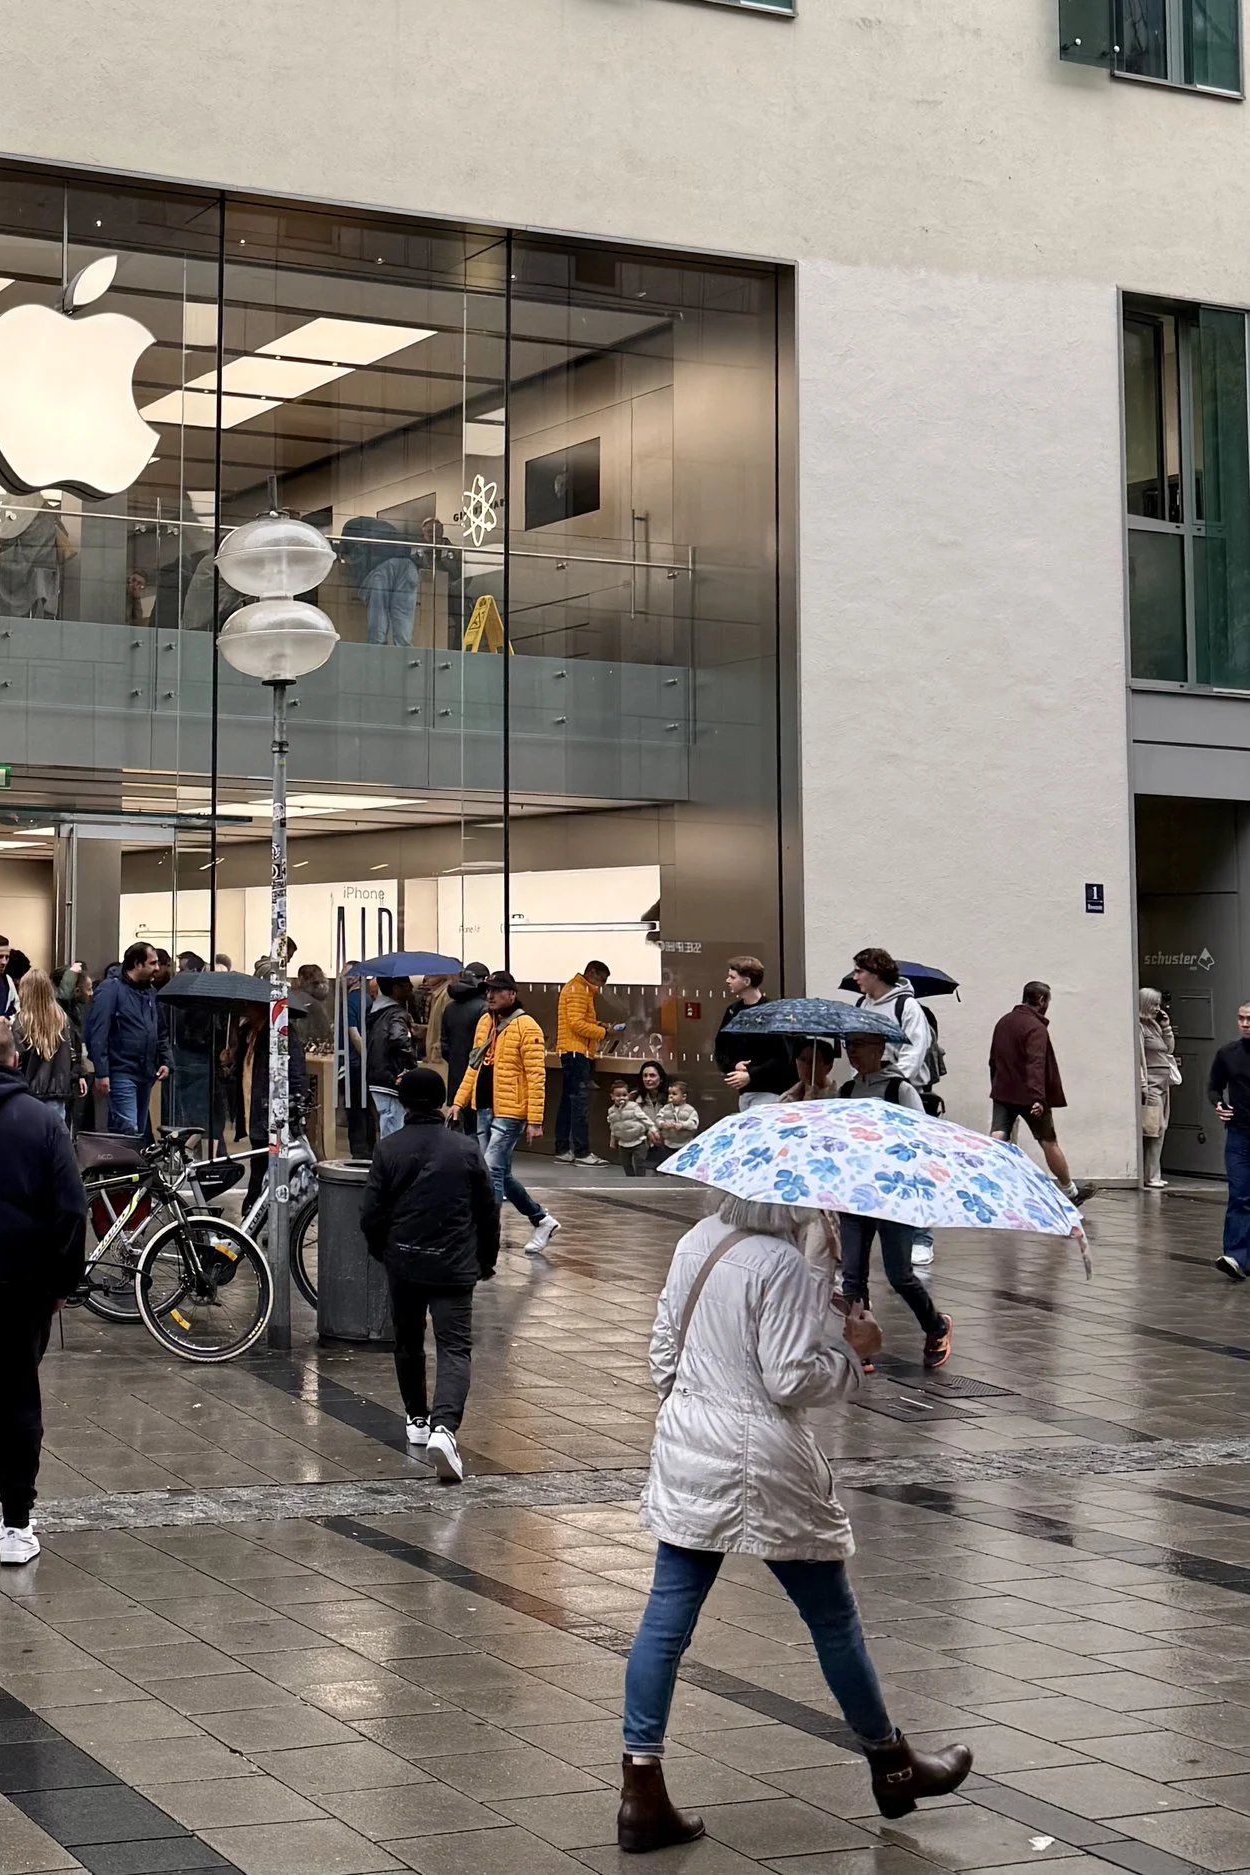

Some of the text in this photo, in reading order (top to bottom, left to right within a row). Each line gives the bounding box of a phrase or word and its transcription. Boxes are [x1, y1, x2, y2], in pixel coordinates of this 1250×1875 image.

[343, 886, 385, 900] iPhone
[1092, 886, 1098, 900] 1
[1143, 950, 1197, 965] schuster
